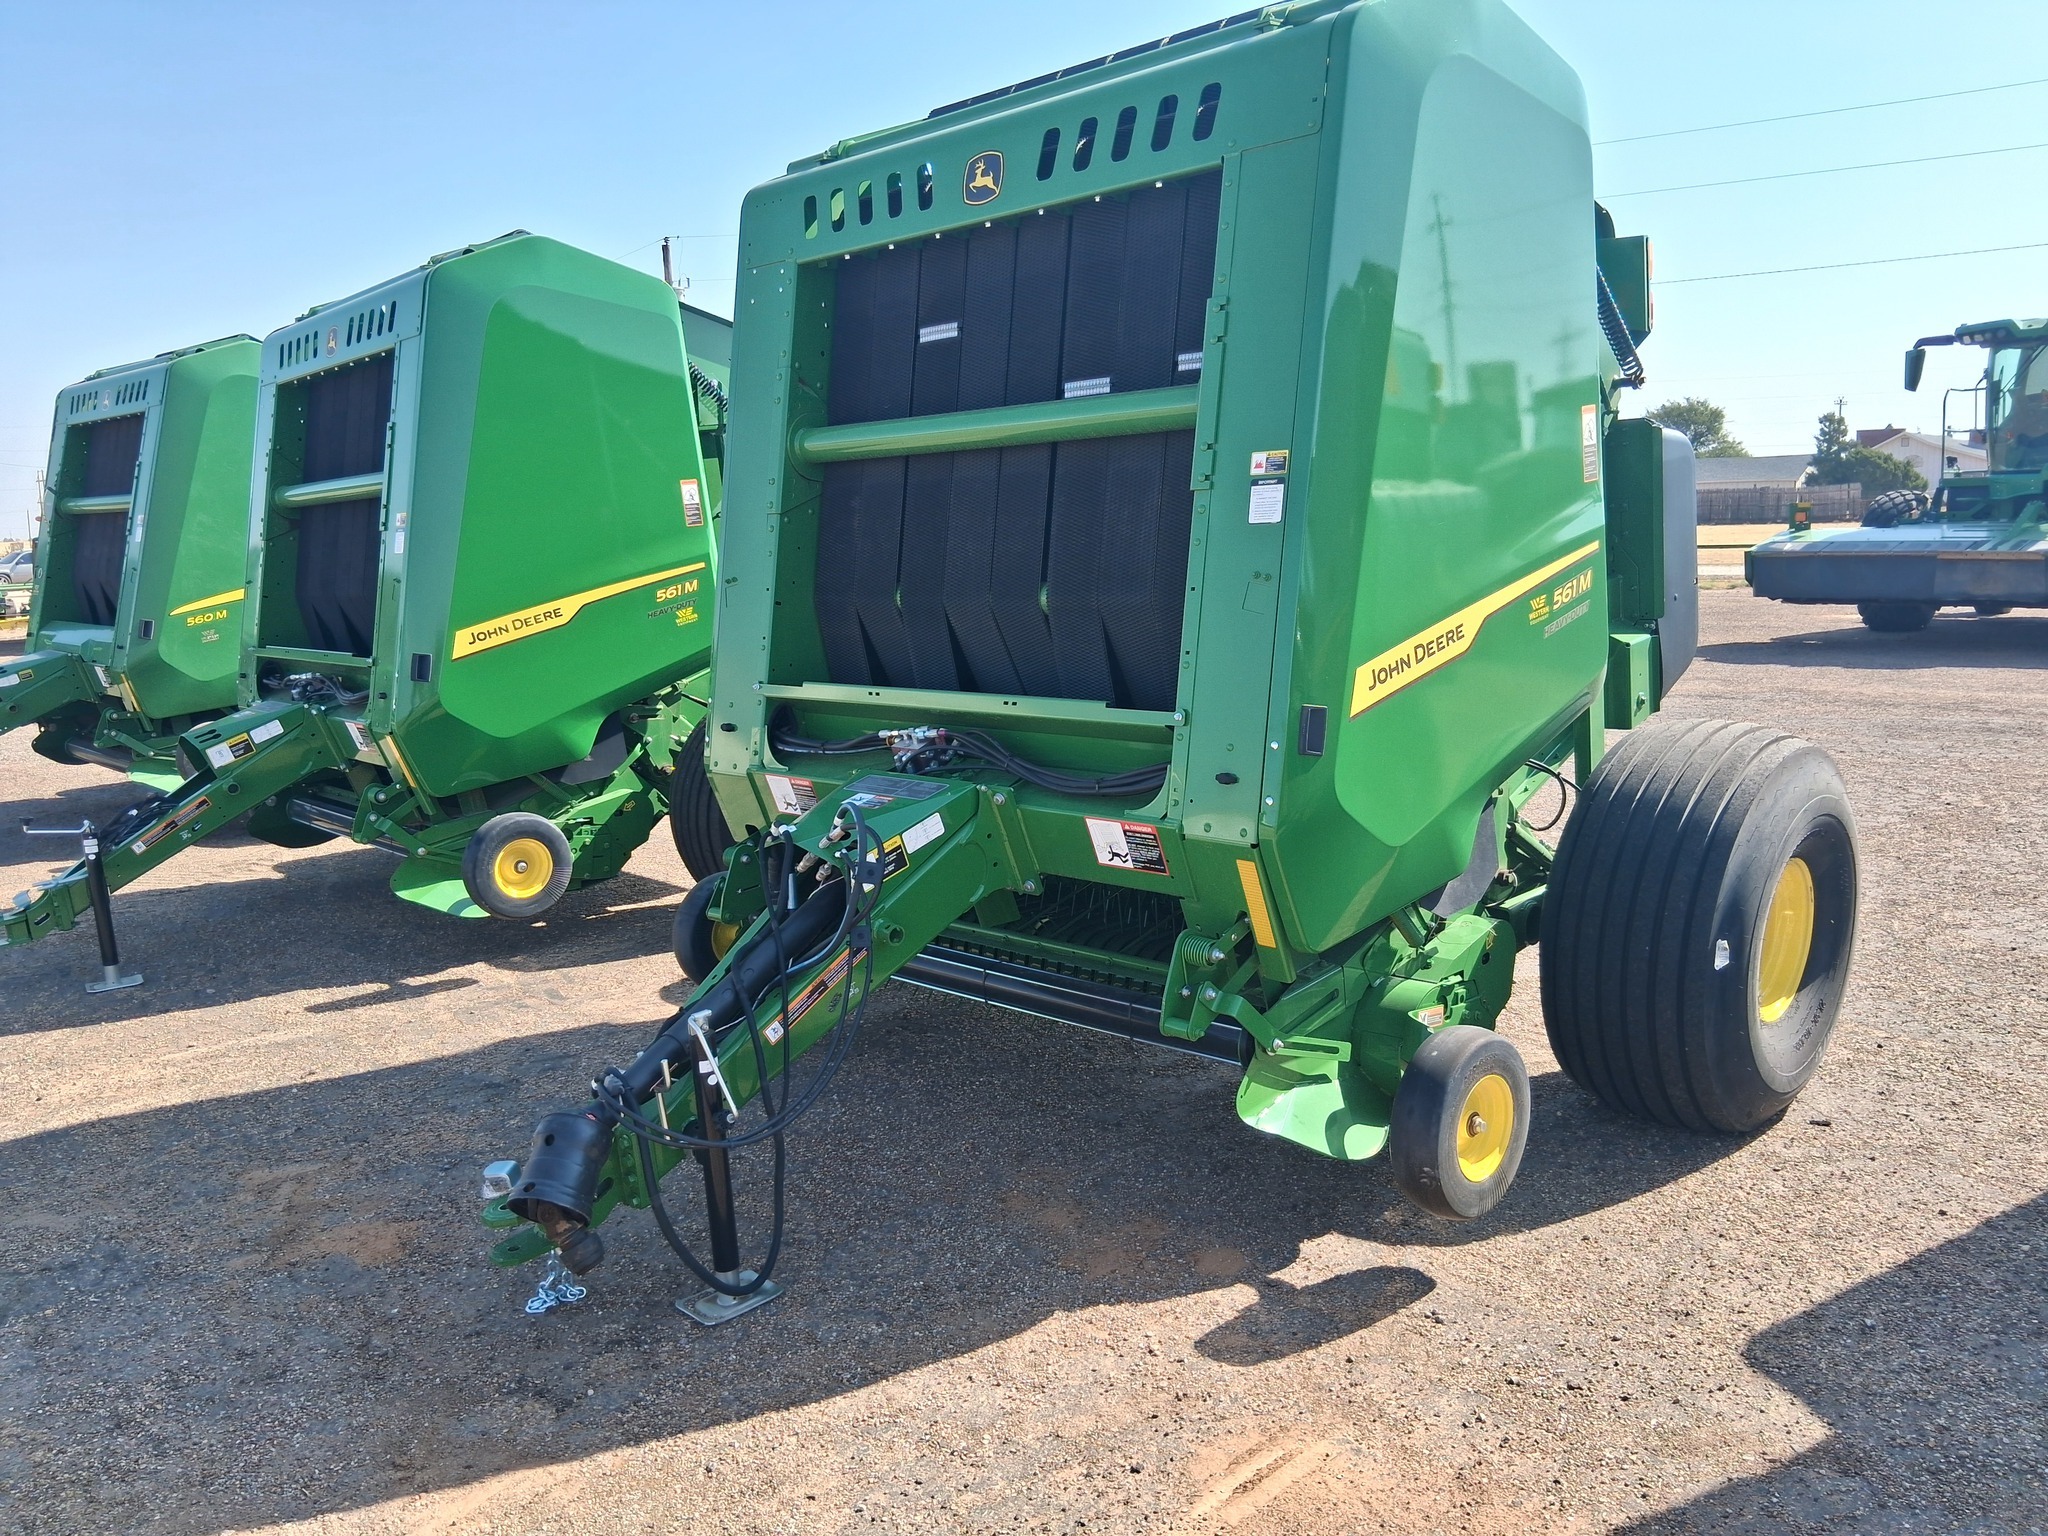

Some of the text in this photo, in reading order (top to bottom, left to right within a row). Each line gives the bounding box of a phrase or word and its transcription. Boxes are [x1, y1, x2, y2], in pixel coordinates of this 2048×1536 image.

[469, 607, 564, 645] JOHN DEERE
[1368, 622, 1466, 691] JOHN DEERE
[1130, 824, 1153, 832] DANGER
